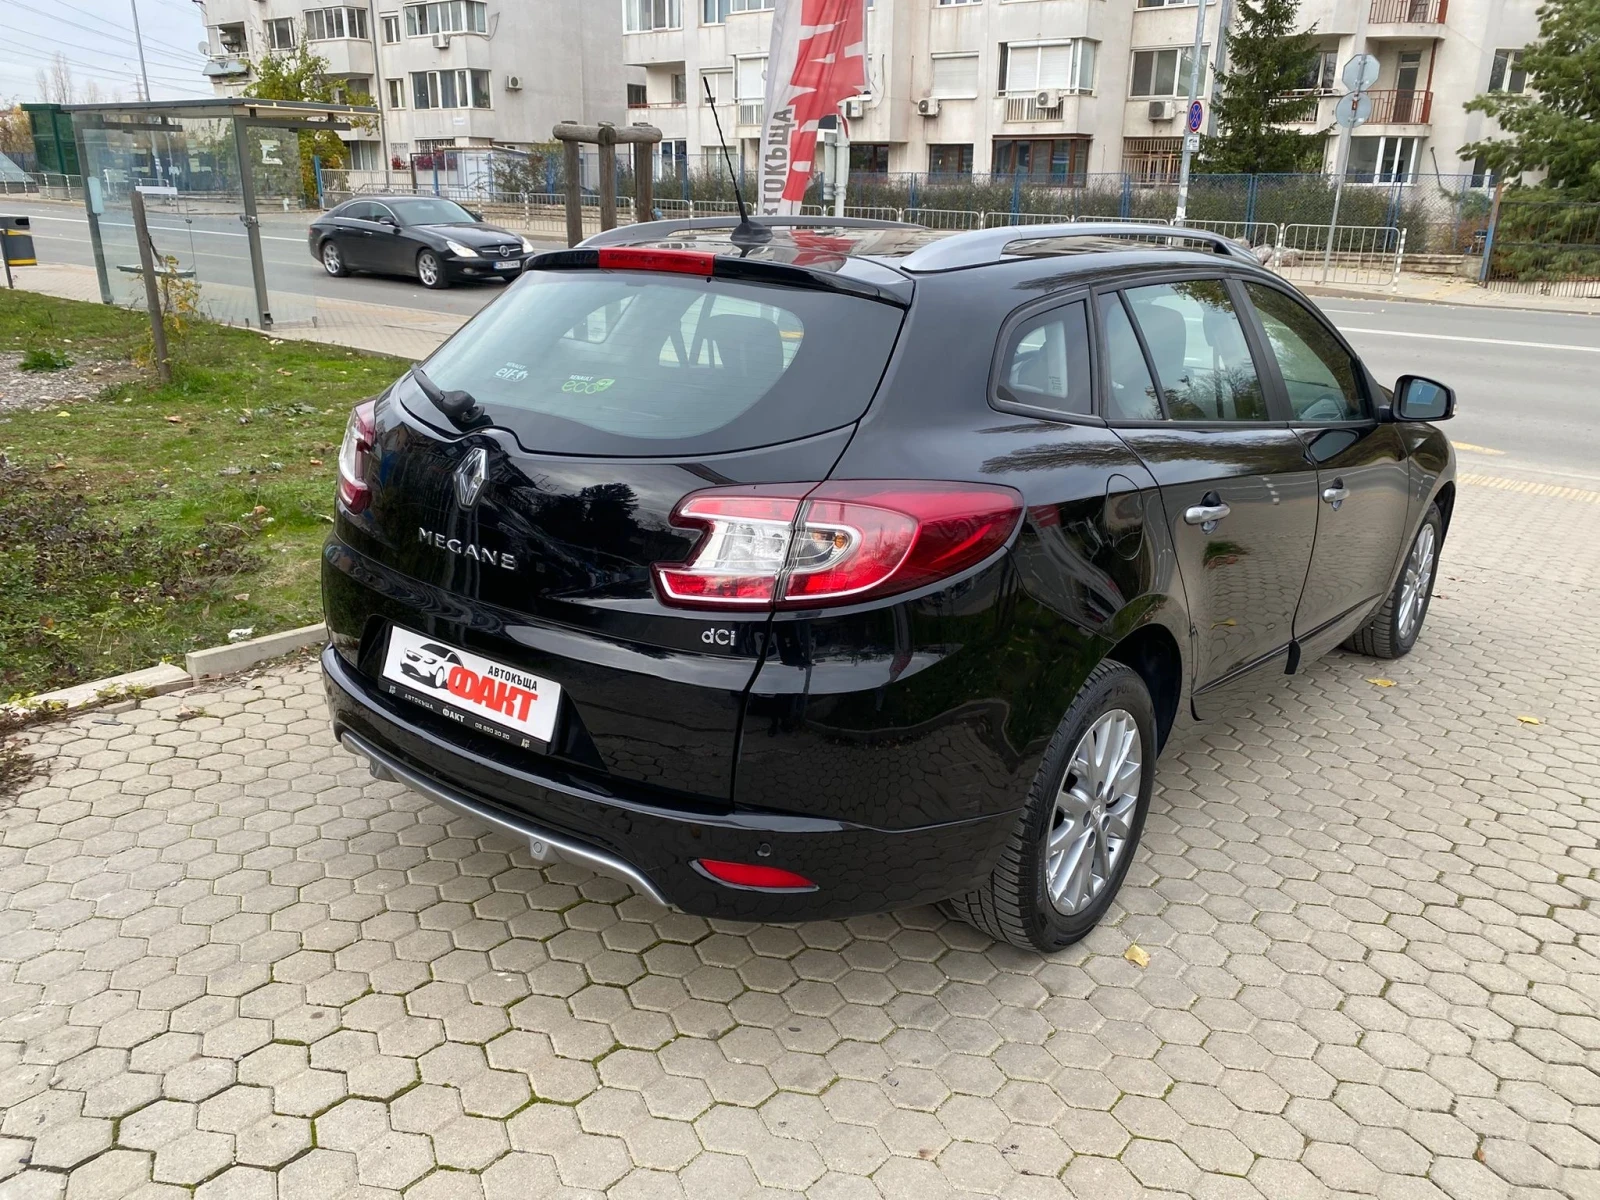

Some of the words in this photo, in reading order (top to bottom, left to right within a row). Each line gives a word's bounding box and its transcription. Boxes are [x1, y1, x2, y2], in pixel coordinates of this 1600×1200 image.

[418, 527, 517, 570] MEGANE
[701, 627, 736, 646] dCi
[487, 665, 538, 692] АВТОКЪЩА
[447, 666, 538, 722] ФАКТ
[442, 708, 465, 723] ФАКТ
